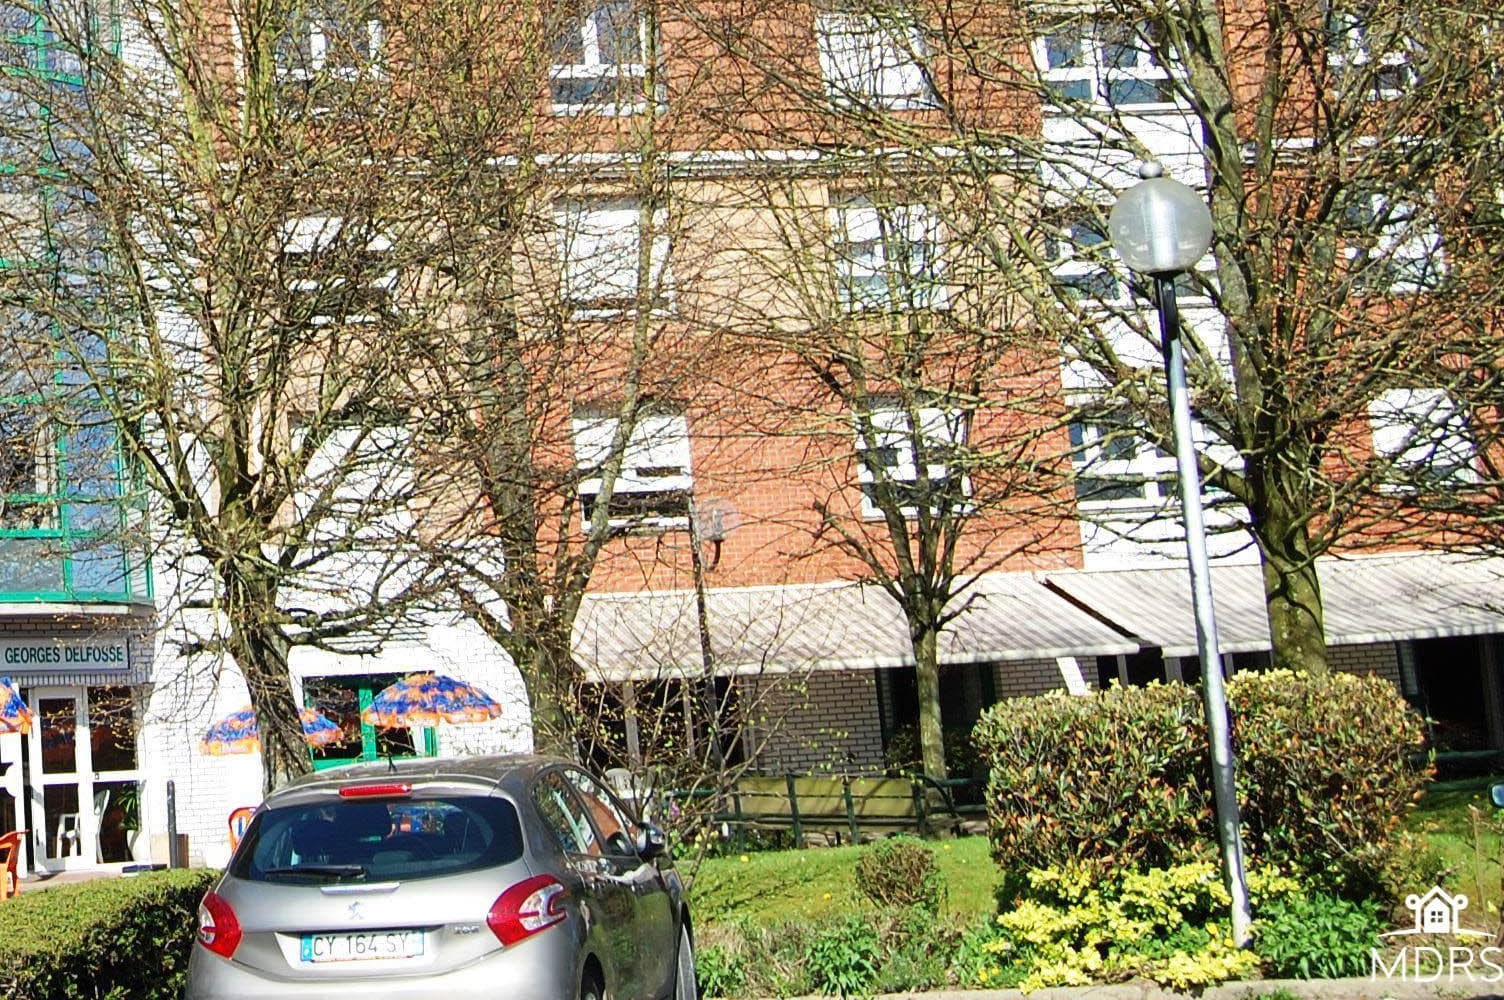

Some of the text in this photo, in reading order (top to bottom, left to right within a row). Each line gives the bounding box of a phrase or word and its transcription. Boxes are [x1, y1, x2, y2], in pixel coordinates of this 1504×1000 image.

[4, 646, 60, 664] GEORGES
[64, 645, 124, 663] DELFOSSE
[313, 932, 410, 957] CY 164 SY
